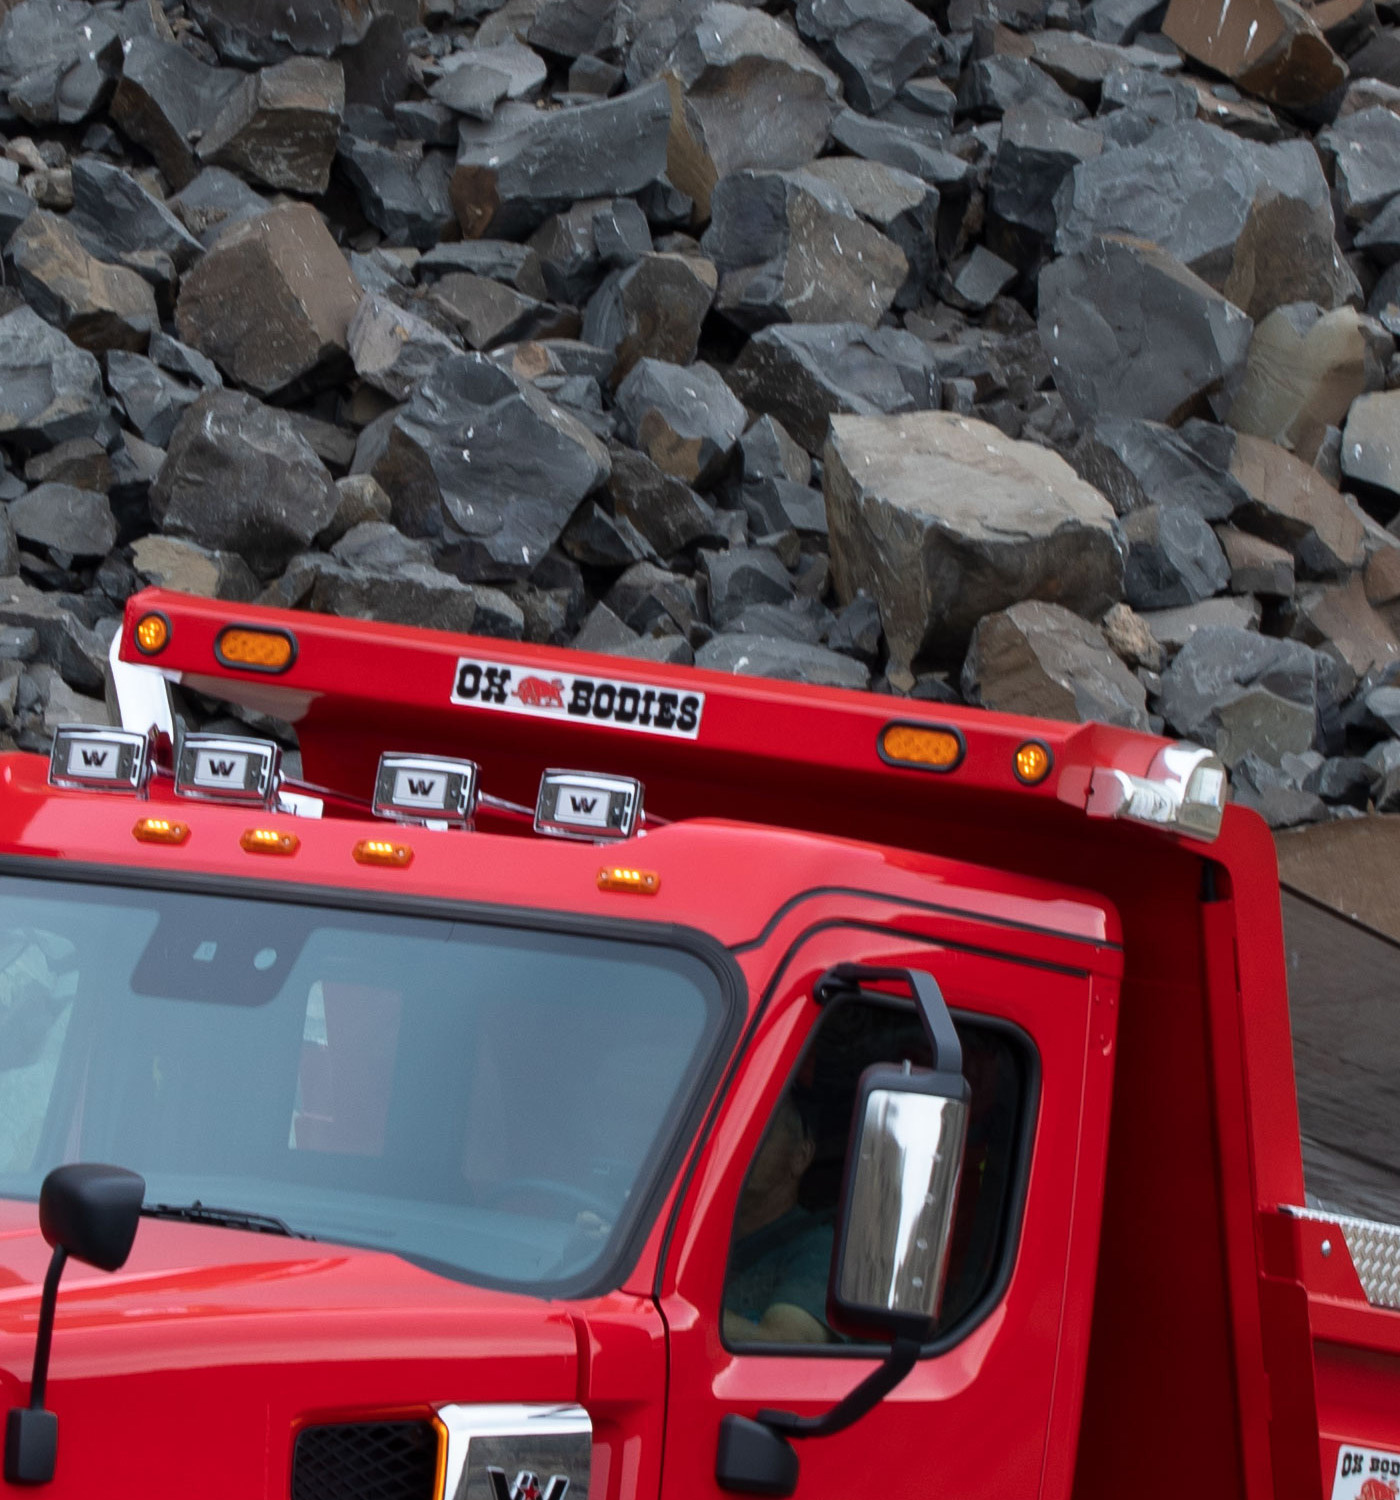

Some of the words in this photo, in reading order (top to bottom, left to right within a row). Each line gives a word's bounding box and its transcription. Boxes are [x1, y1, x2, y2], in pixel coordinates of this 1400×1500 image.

[456, 663, 511, 704] OX
[567, 679, 700, 732] BODIES
[1341, 1452, 1364, 1477] OX
